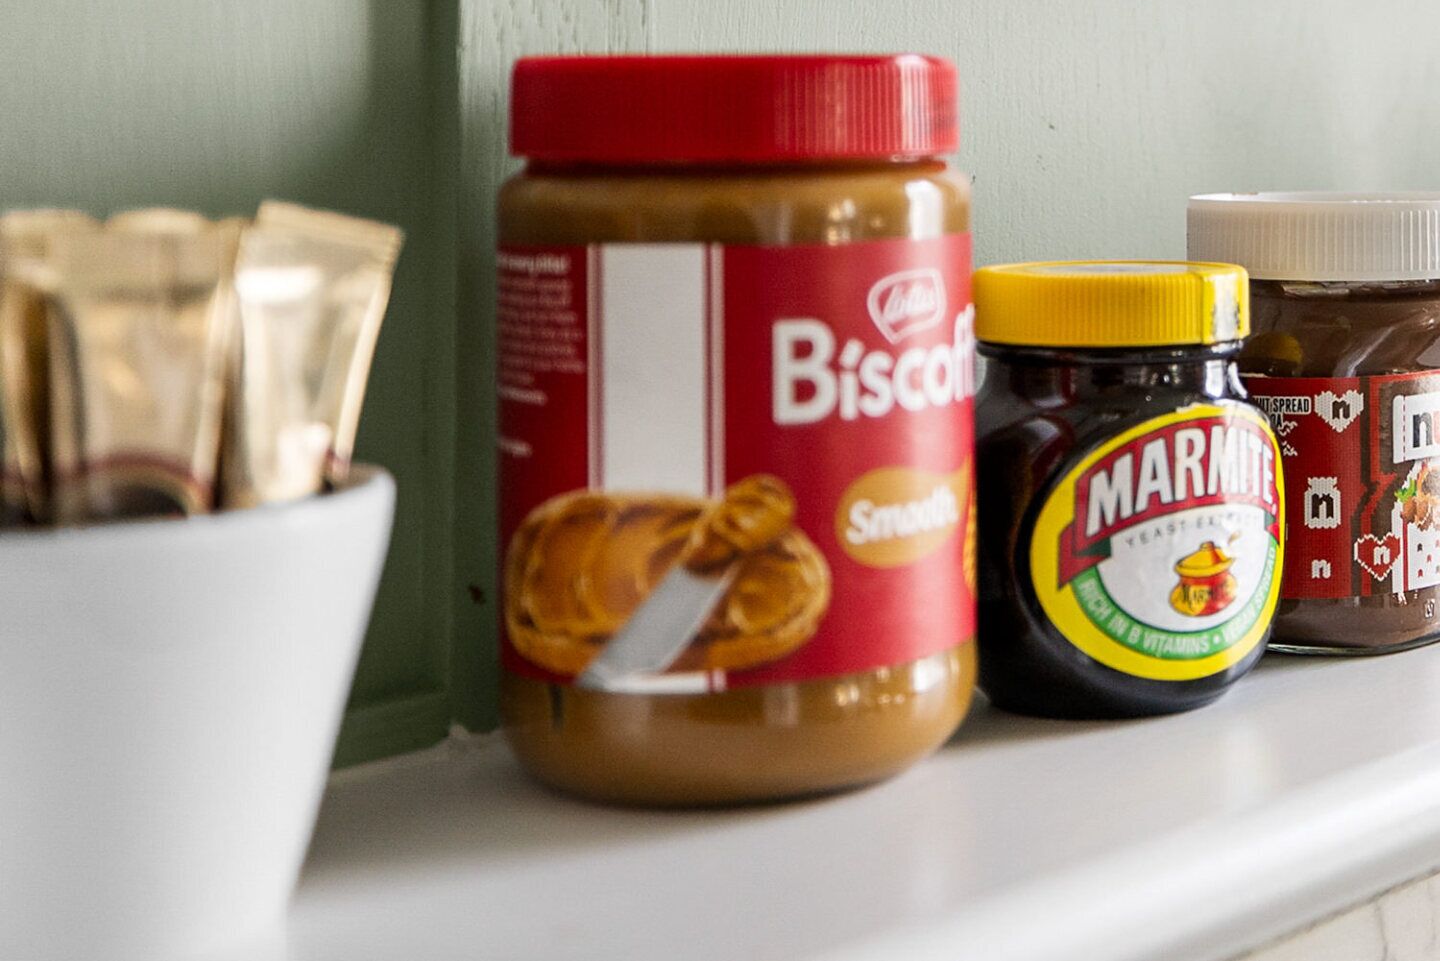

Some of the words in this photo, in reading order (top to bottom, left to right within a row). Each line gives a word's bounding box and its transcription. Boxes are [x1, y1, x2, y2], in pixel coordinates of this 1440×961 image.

[1272, 397, 1311, 413] SPREAD
[1085, 425, 1273, 538] MARMITE
[845, 485, 958, 545] Smooth
[1126, 519, 1186, 548] YEAST
[1107, 613, 1129, 638] IN
[1143, 629, 1210, 658] VITAMINS
